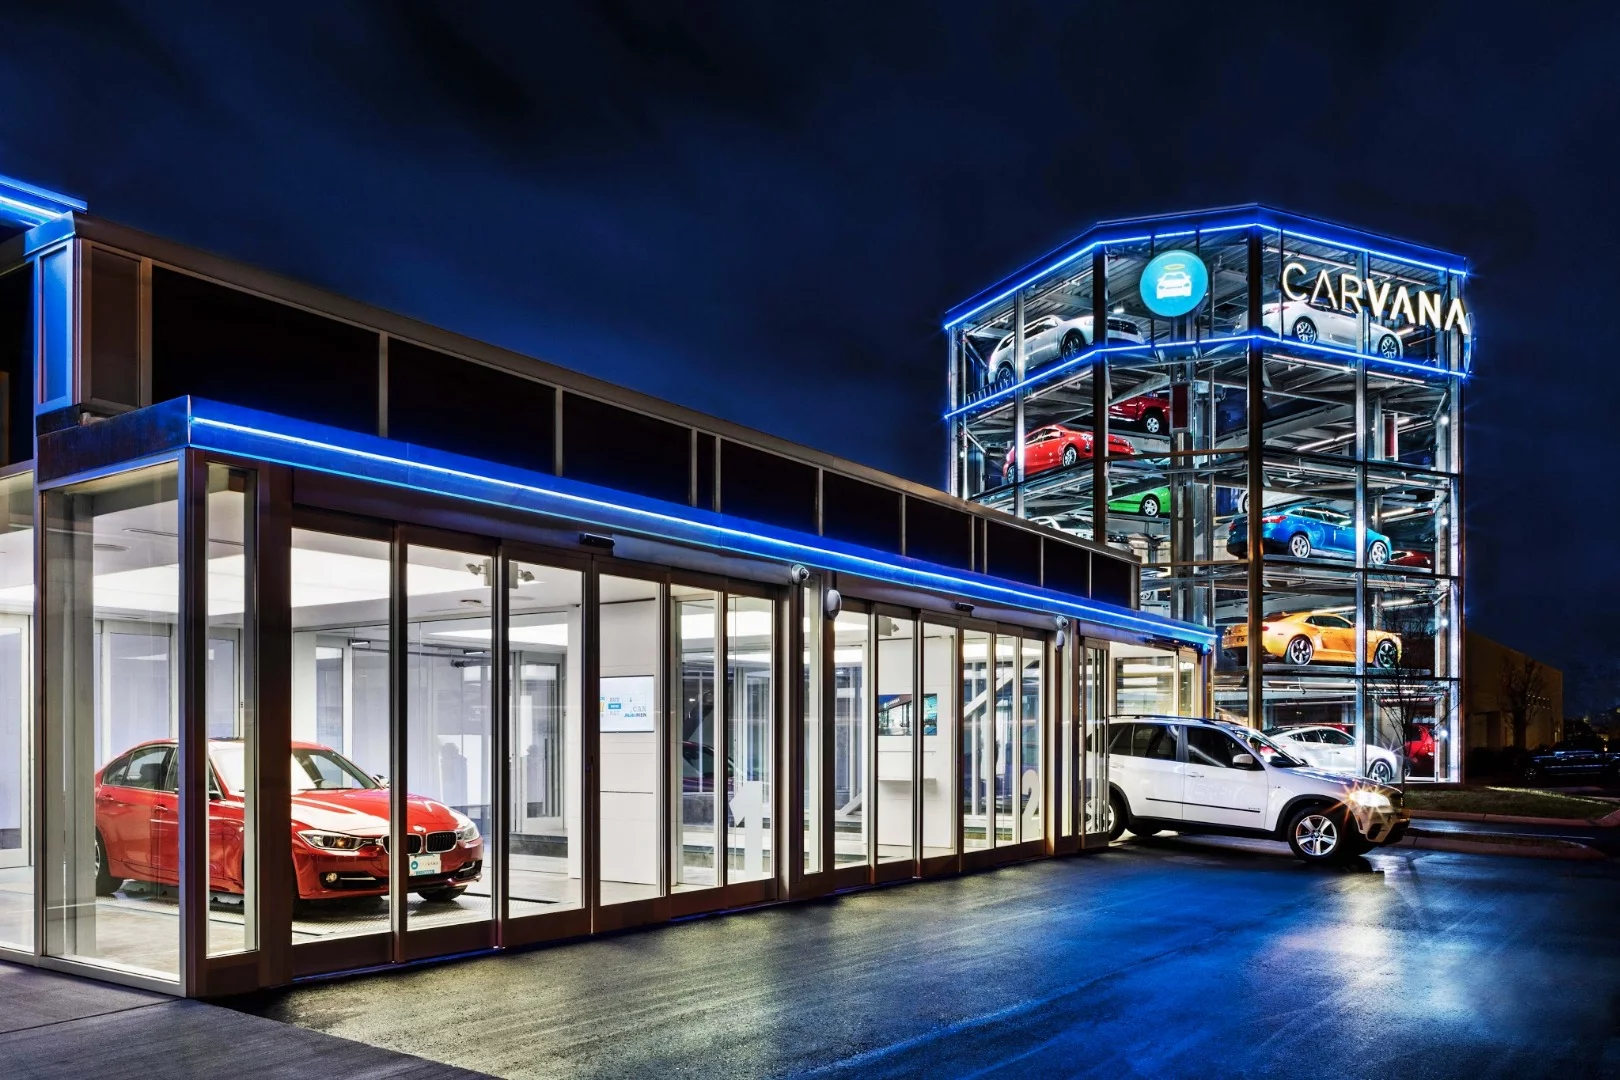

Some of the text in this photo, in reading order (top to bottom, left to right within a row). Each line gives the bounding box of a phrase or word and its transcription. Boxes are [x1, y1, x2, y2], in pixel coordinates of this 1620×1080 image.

[1282, 262, 1469, 335] CARVANA
[728, 780, 763, 881] 1
[1022, 769, 1040, 838] 2
